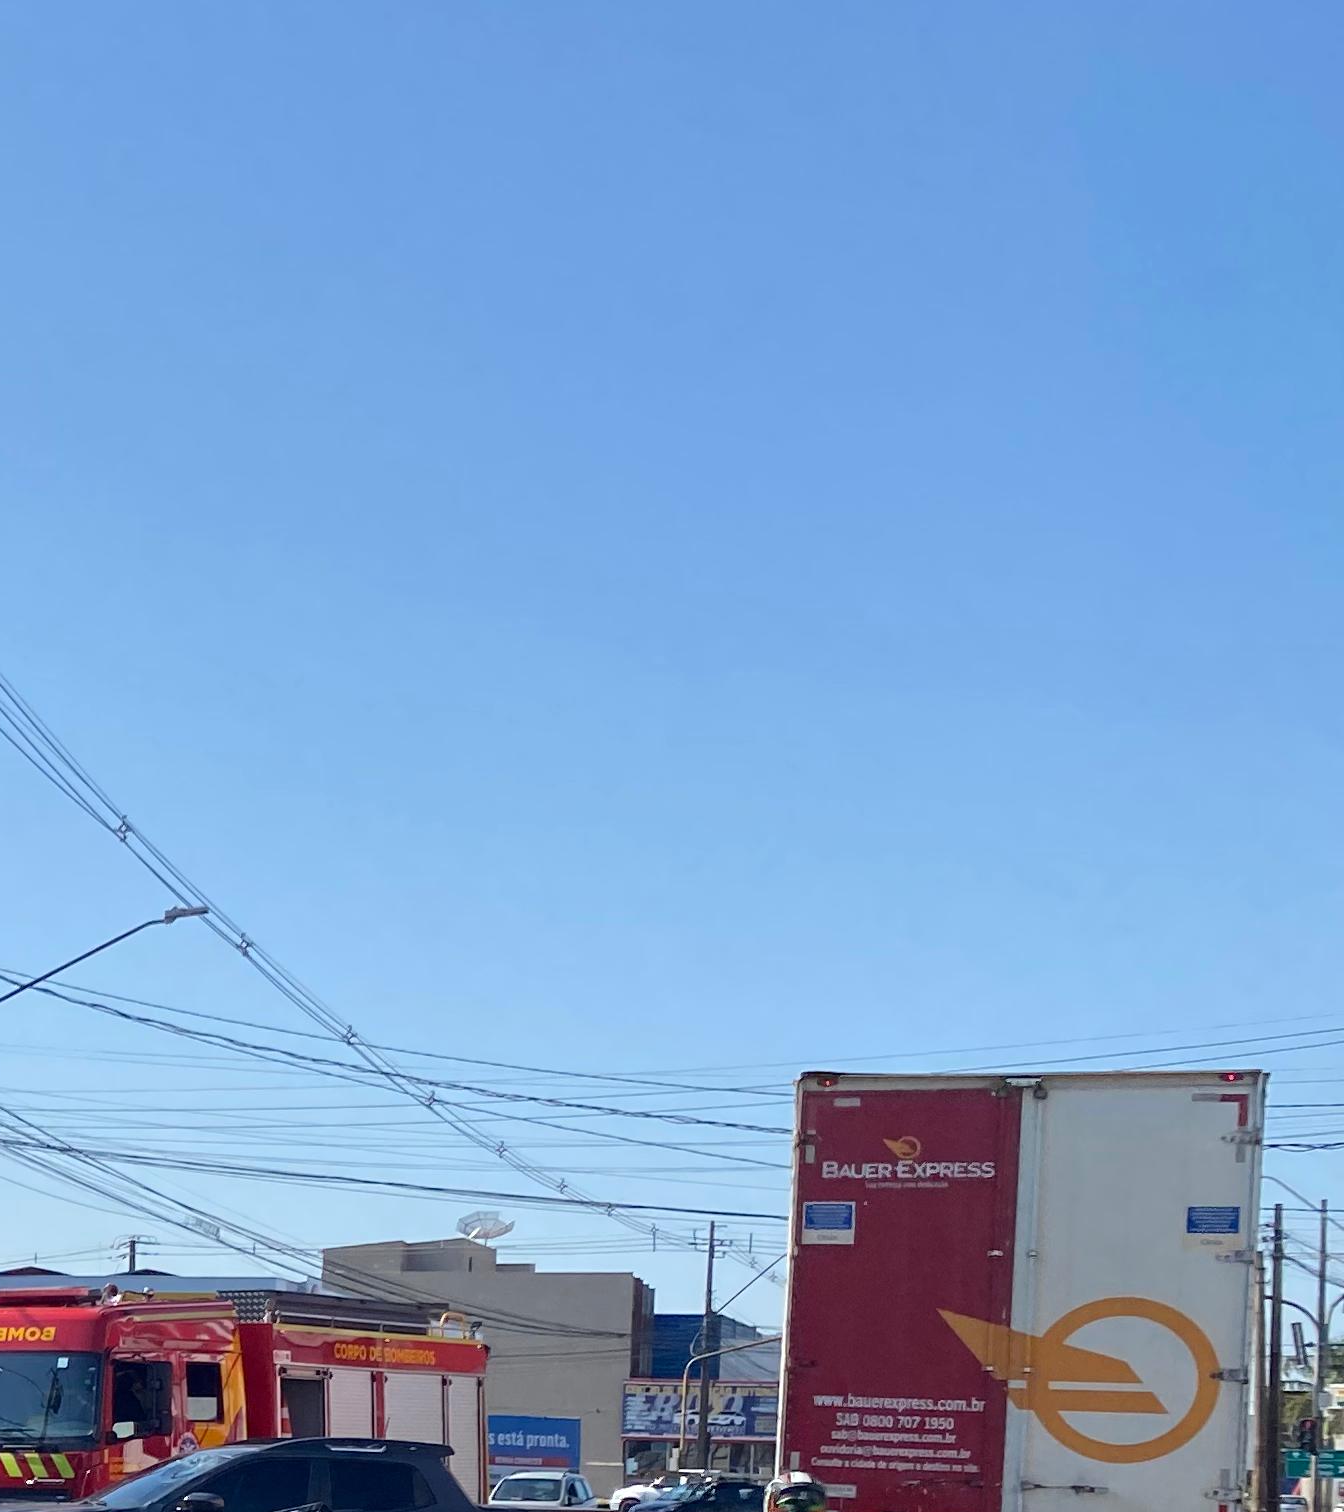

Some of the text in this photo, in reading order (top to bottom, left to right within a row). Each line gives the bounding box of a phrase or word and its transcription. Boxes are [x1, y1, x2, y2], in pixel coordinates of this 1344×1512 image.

[333, 1342, 436, 1366] CORPO DE BOMBEIROS
[814, 1393, 986, 1412] www.bauerexpress.com.br
[863, 1414, 893, 1428] 0800
[896, 1415, 921, 1429] 707
[924, 1417, 954, 1430] 1950
[497, 1430, 524, 1446] está
[526, 1433, 570, 1449] pronta.
